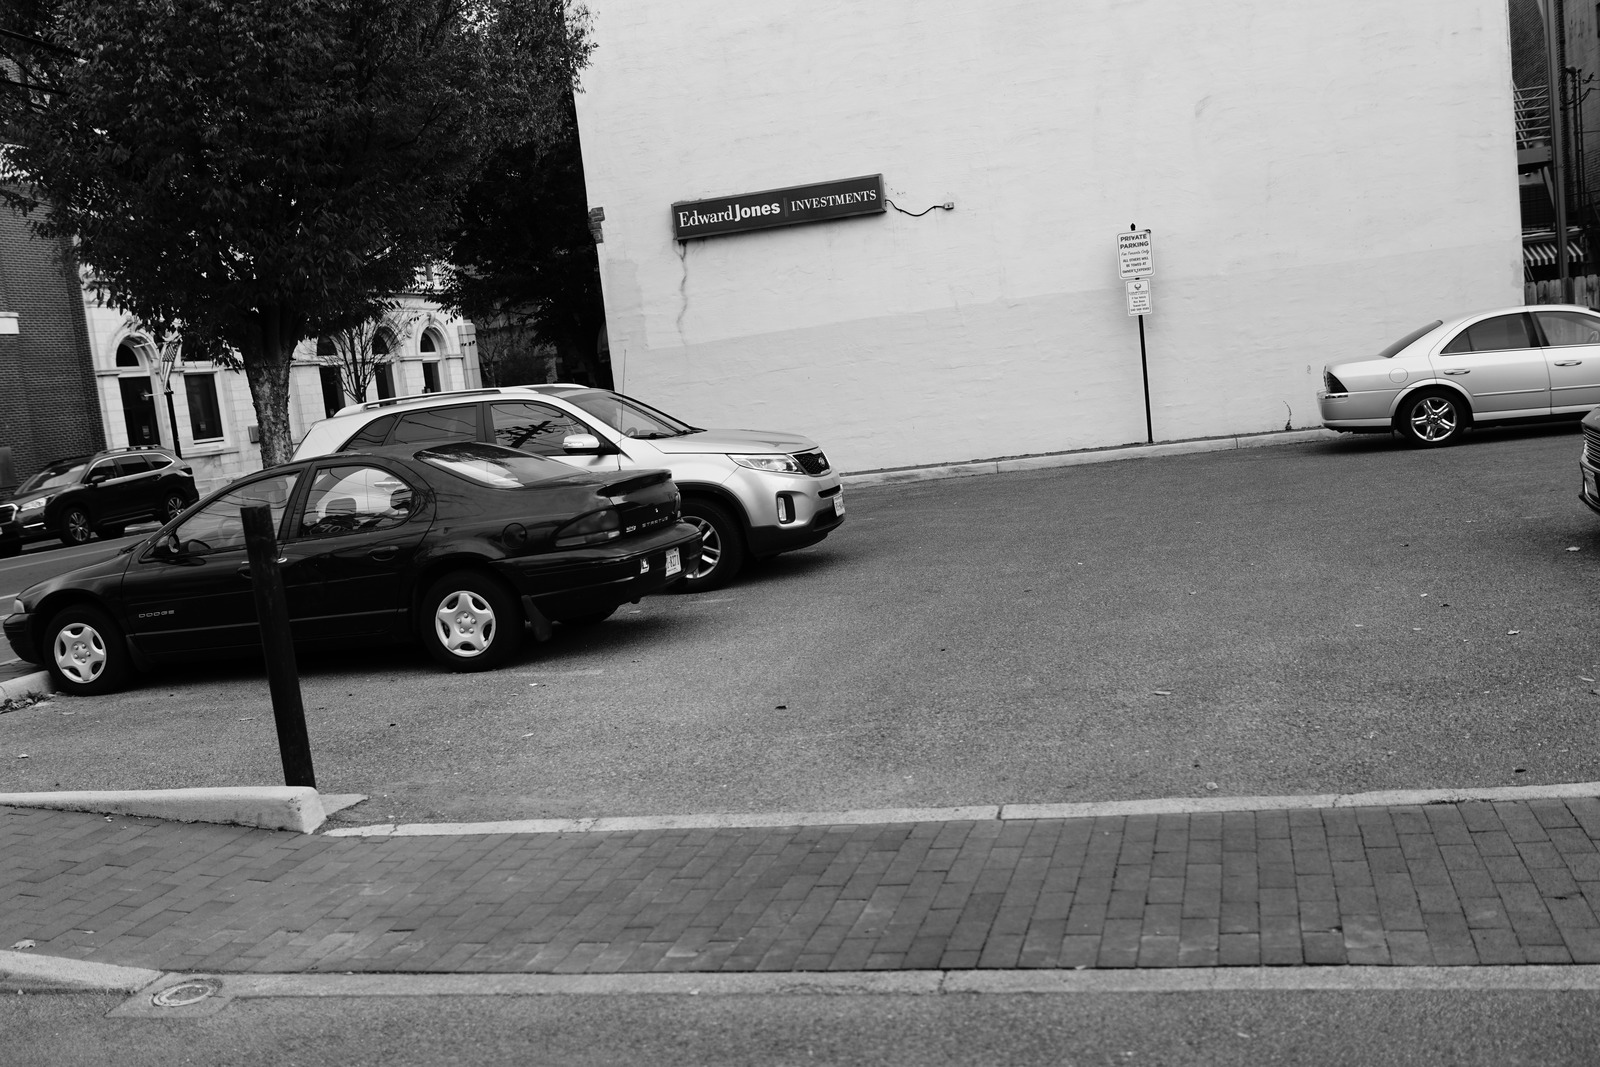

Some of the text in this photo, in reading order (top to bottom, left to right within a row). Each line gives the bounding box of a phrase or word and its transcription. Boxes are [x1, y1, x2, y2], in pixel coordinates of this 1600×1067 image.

[791, 189, 877, 212] INVESTMENTS
[1120, 234, 1147, 242] PRIVATE
[1120, 241, 1149, 249] PARKING
[138, 610, 175, 619] DODGE
